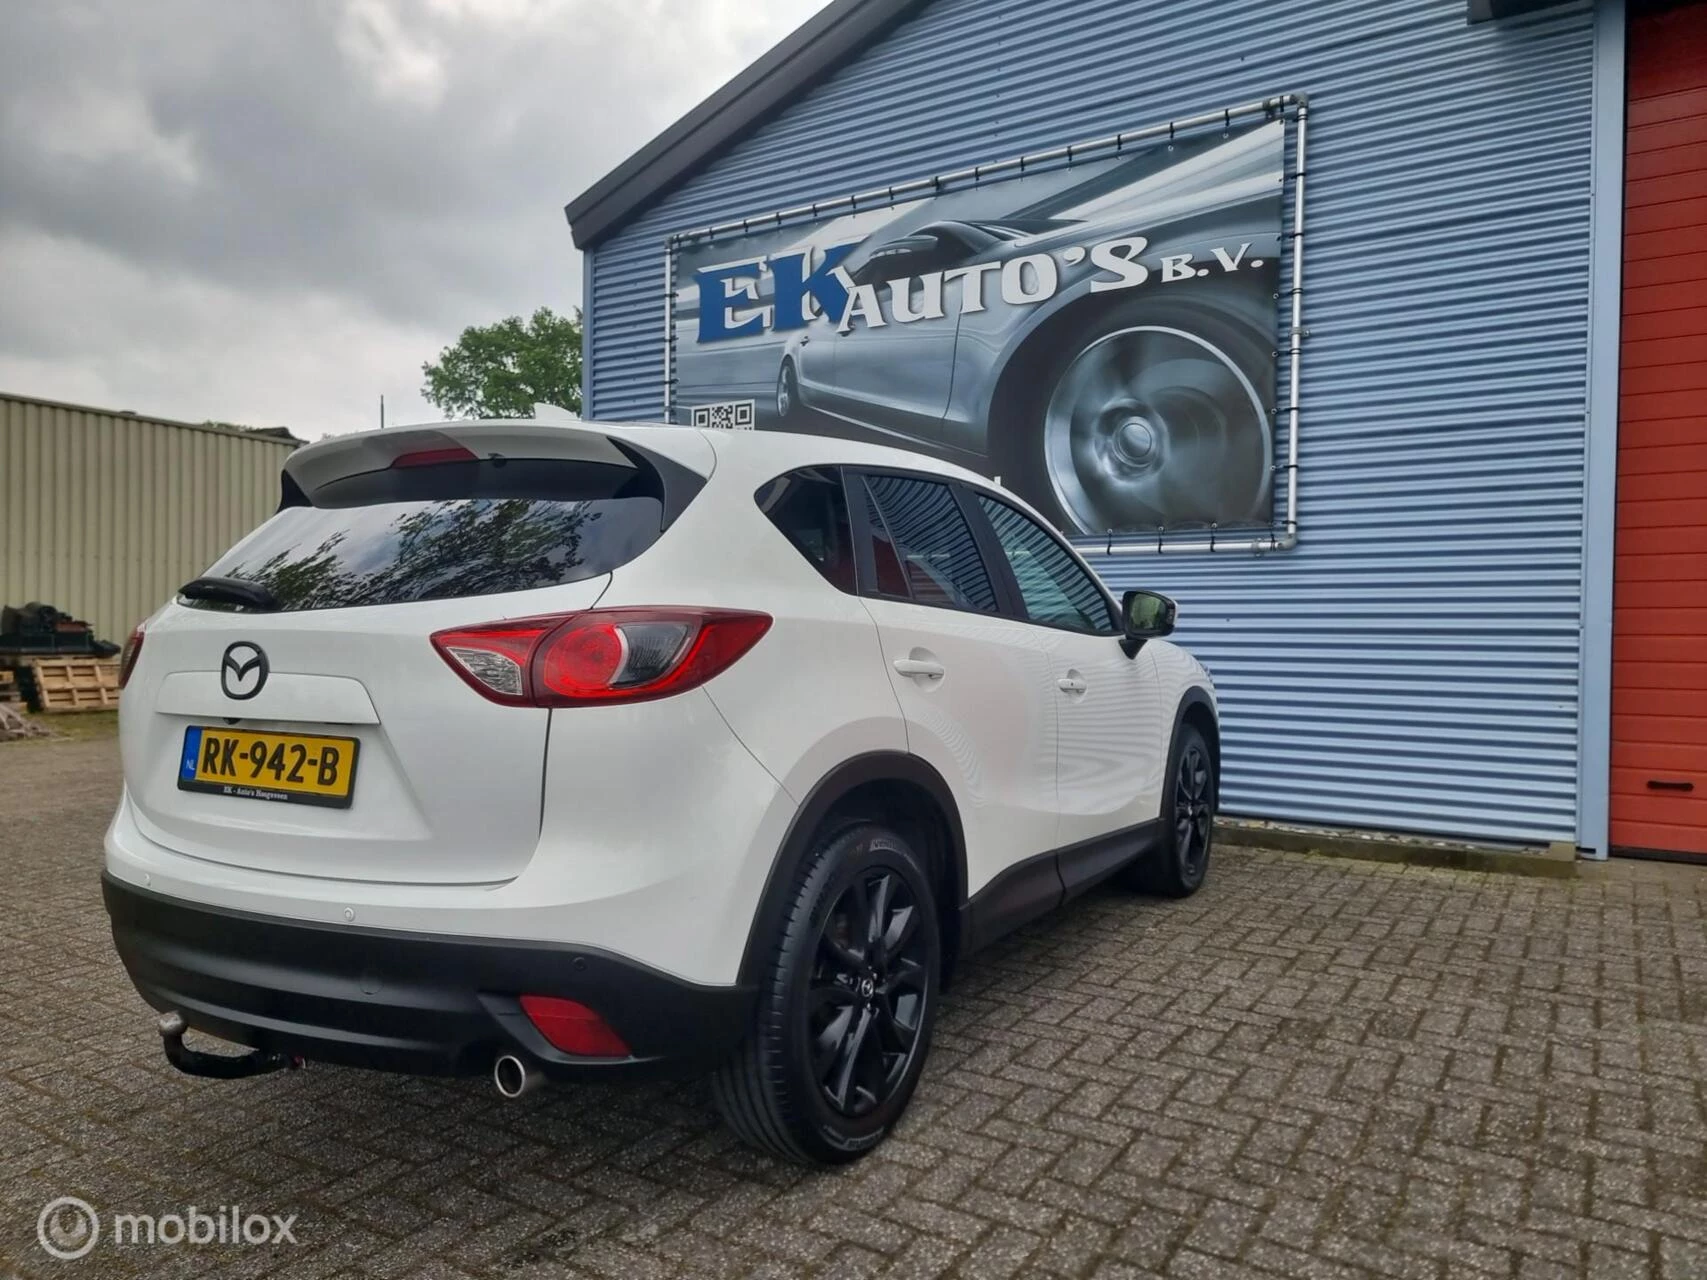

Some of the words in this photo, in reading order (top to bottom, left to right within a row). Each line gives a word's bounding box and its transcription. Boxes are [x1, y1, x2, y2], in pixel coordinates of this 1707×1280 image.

[695, 240, 862, 344] EK
[837, 235, 1149, 334] AUTO'S
[1160, 242, 1265, 283] B.V.
[185, 759, 196, 771] NL
[201, 737, 340, 787] RK-942-B
